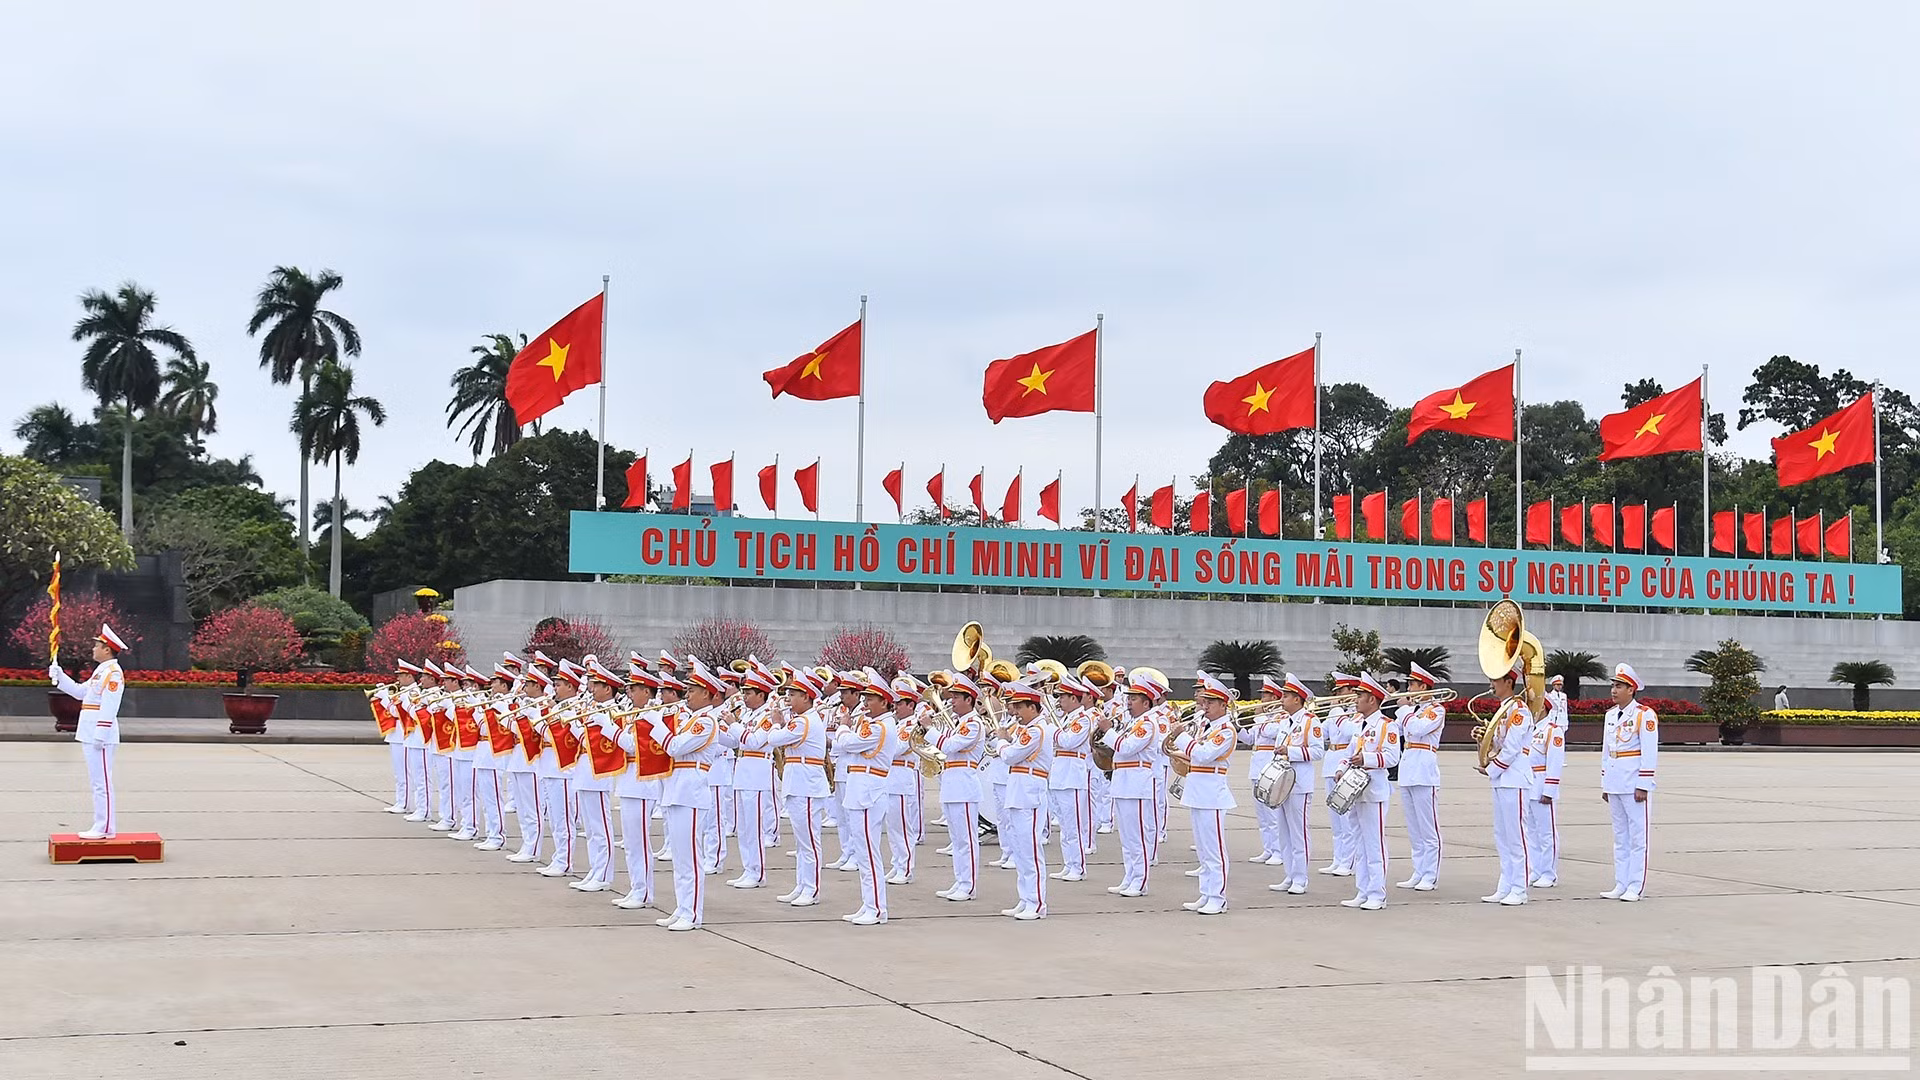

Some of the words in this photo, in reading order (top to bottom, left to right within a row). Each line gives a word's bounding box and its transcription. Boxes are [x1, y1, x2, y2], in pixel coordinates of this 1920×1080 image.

[641, 518, 717, 567] CHỦ
[735, 531, 817, 577] TỊCH
[833, 523, 881, 573] HỒ
[897, 532, 955, 575] CHÍ
[971, 539, 1063, 579] MINH
[1079, 538, 1109, 581] VĨ
[1125, 545, 1179, 589] ĐẠI
[1195, 538, 1281, 585] SỐNG
[1295, 547, 1353, 587] MÃI
[1367, 555, 1467, 591] TRONG
[1479, 557, 1519, 600] SỰ
[1527, 557, 1631, 603] NGHIỆP
[1641, 556, 1695, 599] CỦA
[1707, 563, 1795, 603] CHÚNG
[1805, 573, 1837, 603] TA
[1849, 575, 1855, 605] !
